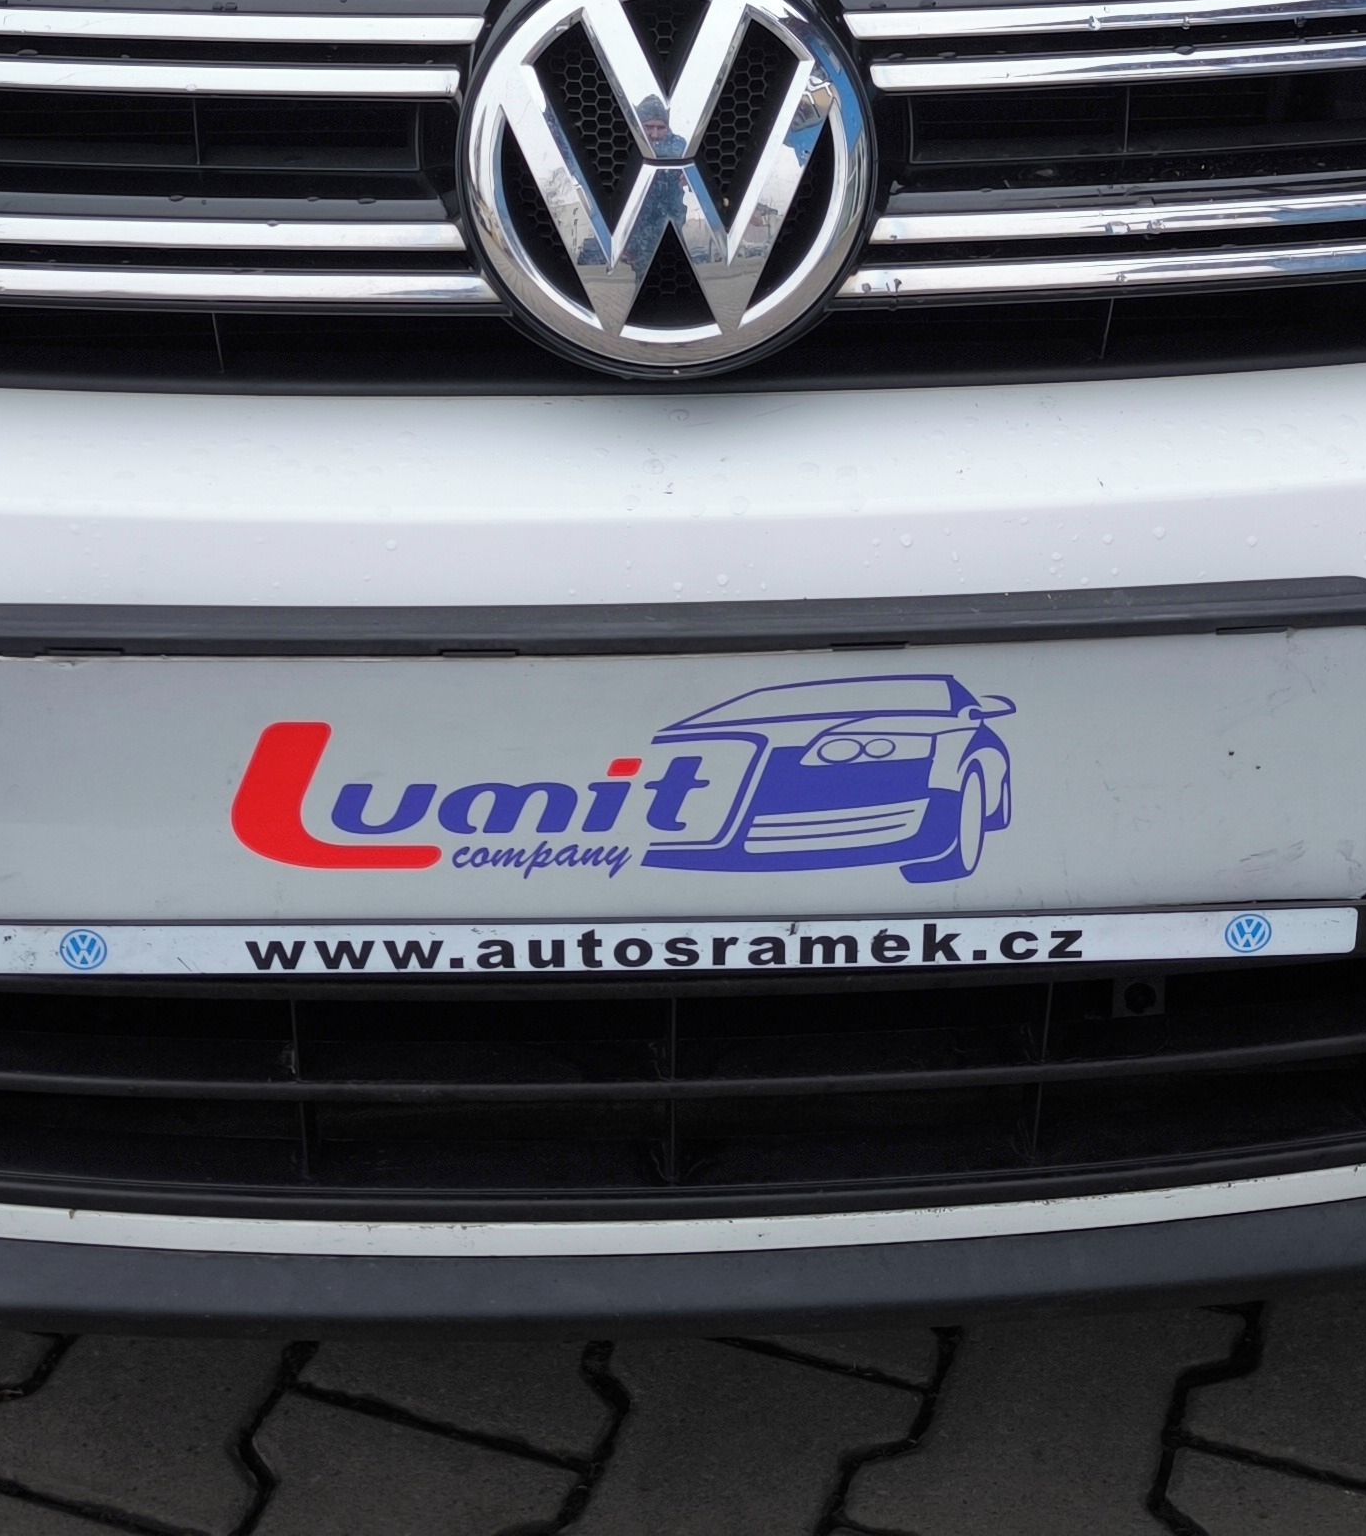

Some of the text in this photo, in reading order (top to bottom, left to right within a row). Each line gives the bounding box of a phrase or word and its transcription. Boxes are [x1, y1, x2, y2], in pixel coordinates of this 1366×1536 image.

[232, 721, 710, 870] Lumit
[452, 840, 633, 879] company
[246, 924, 1084, 969] www.autosramek.cz
